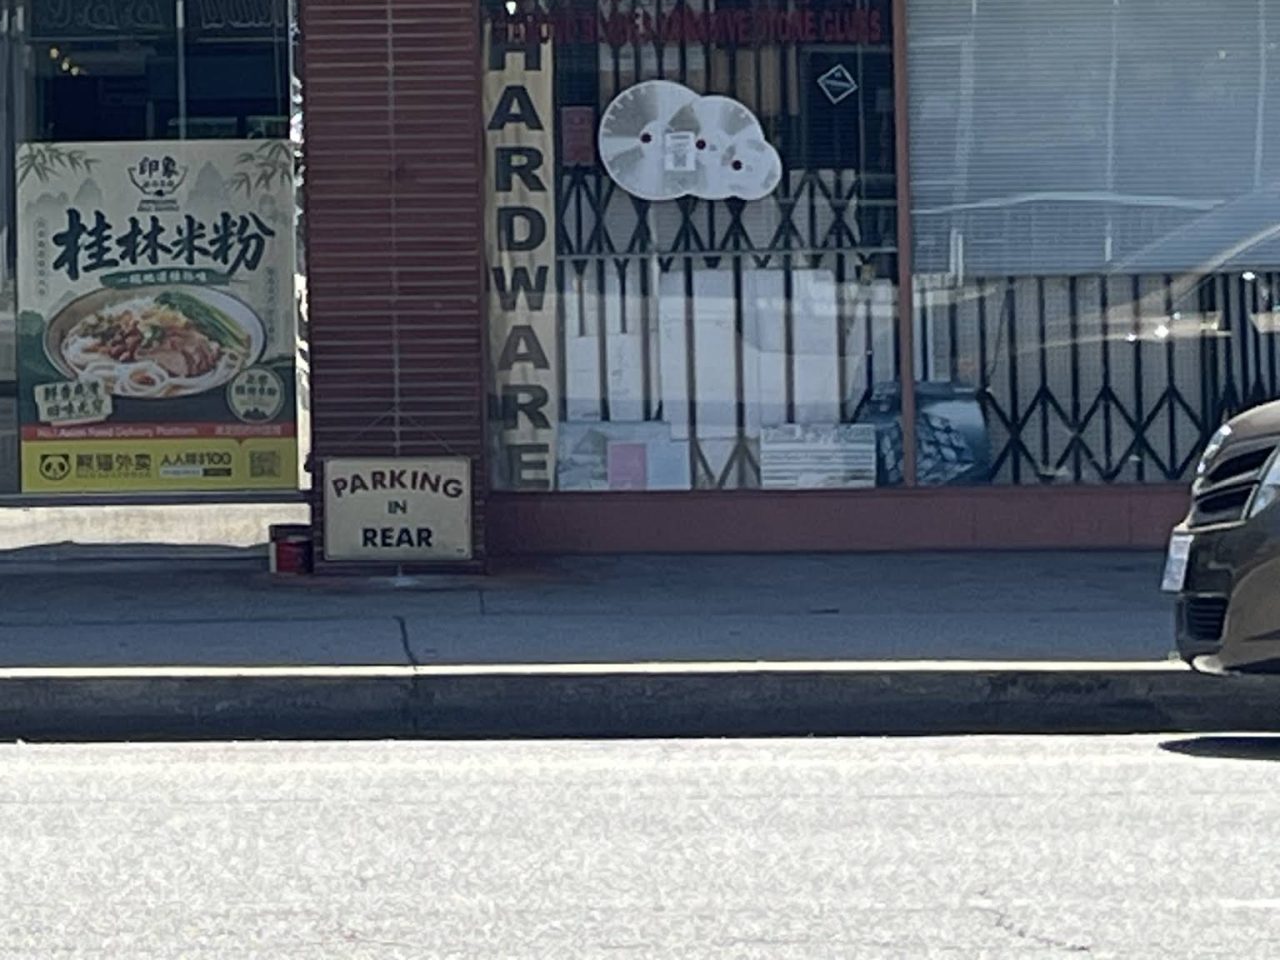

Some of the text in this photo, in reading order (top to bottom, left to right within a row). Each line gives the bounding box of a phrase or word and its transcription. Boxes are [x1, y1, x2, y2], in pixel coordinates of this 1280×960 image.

[138, 156, 180, 179] 印象
[52, 208, 276, 281] 桂林米粉
[487, 25, 552, 490] HARDWARE
[75, 453, 152, 471] 熊猫外卖
[332, 469, 464, 499] PARKING
[387, 500, 408, 515] IN
[361, 527, 433, 548] REAR
